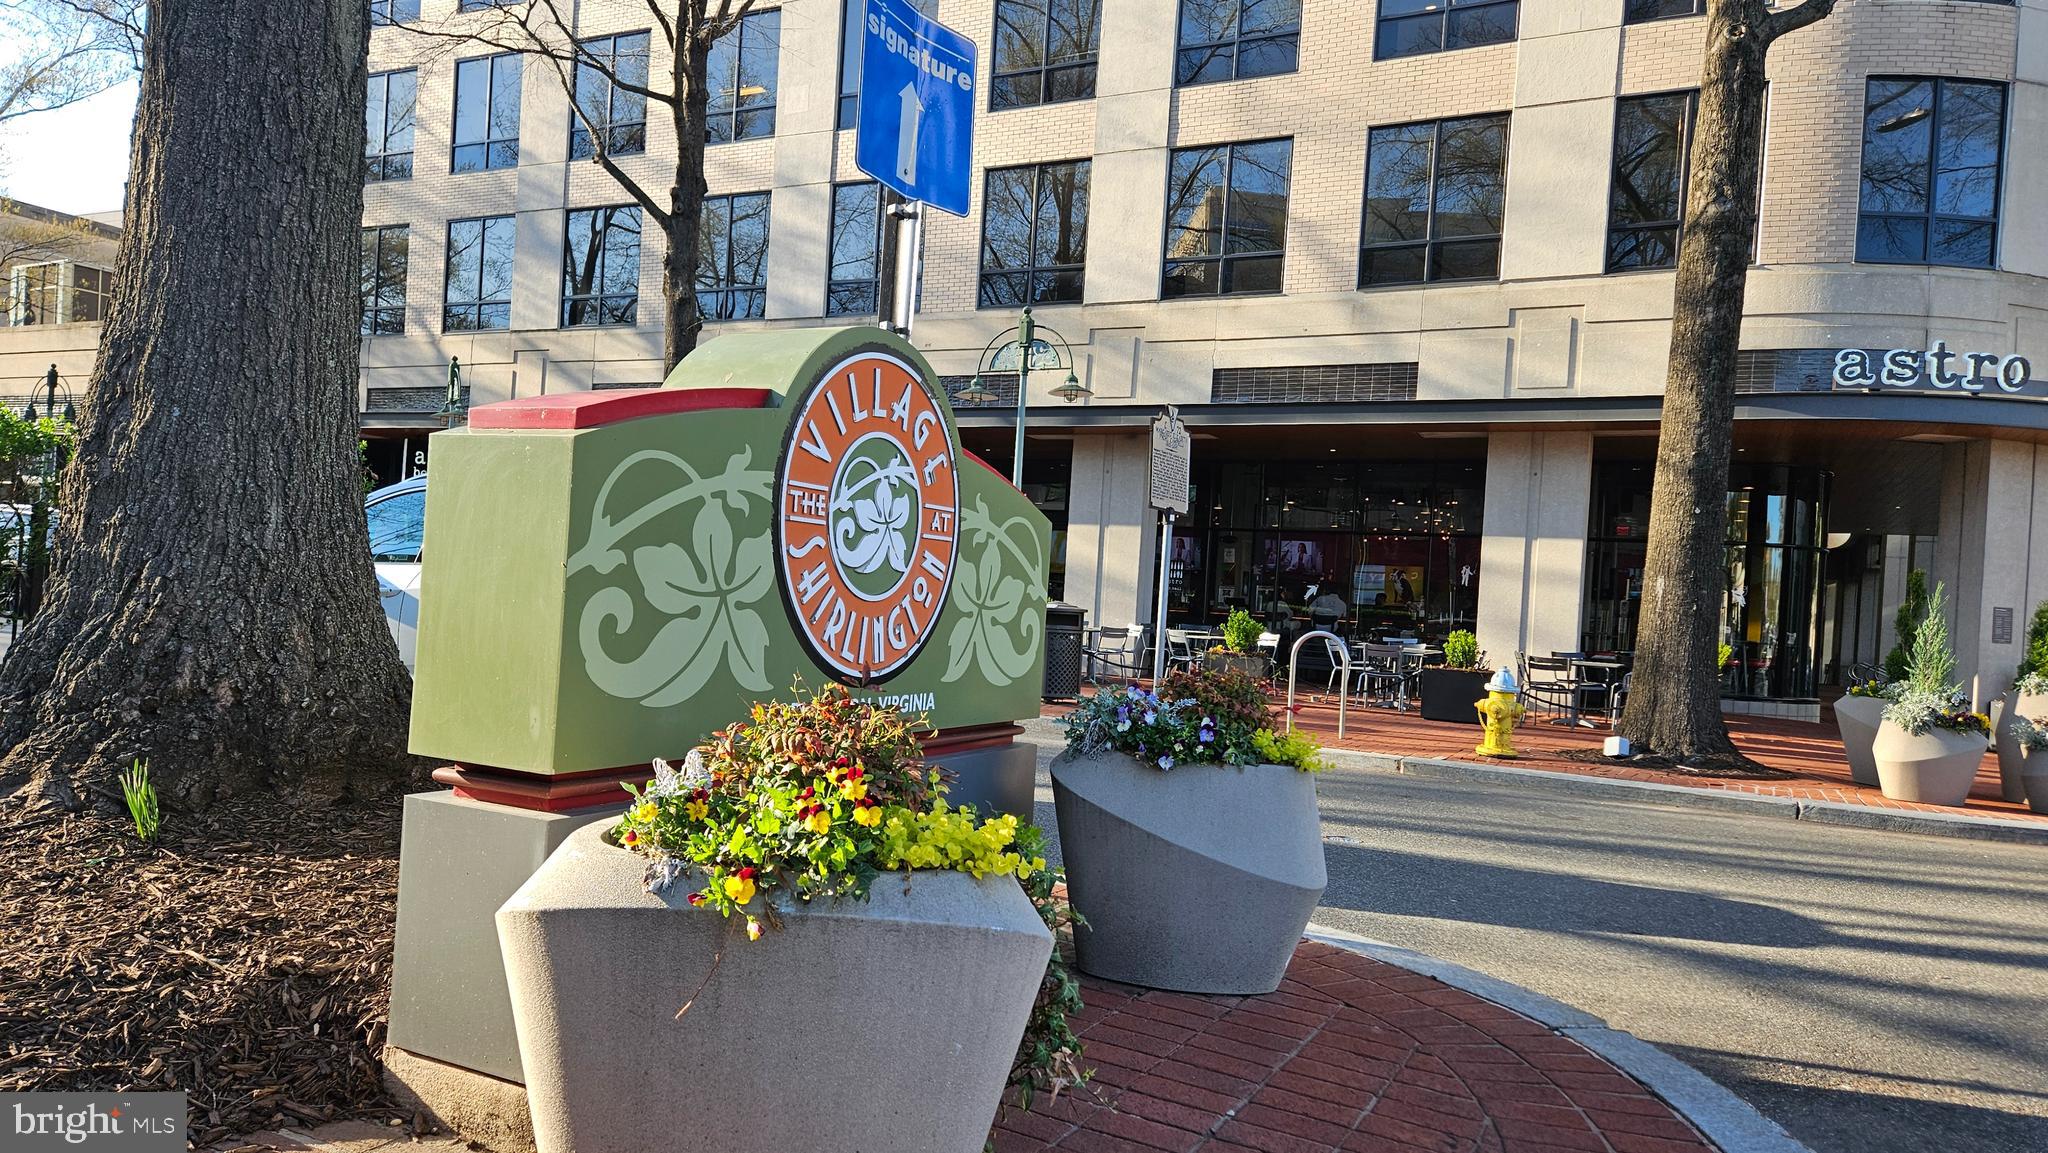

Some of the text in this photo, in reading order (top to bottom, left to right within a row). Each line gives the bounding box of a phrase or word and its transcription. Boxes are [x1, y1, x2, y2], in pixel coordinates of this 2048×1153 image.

[868, 13, 972, 91] signature
[1833, 340, 2031, 392] astro
[788, 367, 952, 664] THE VILLAGE AT SHIRLINGTON
[878, 692, 935, 713] VIRGINIA
